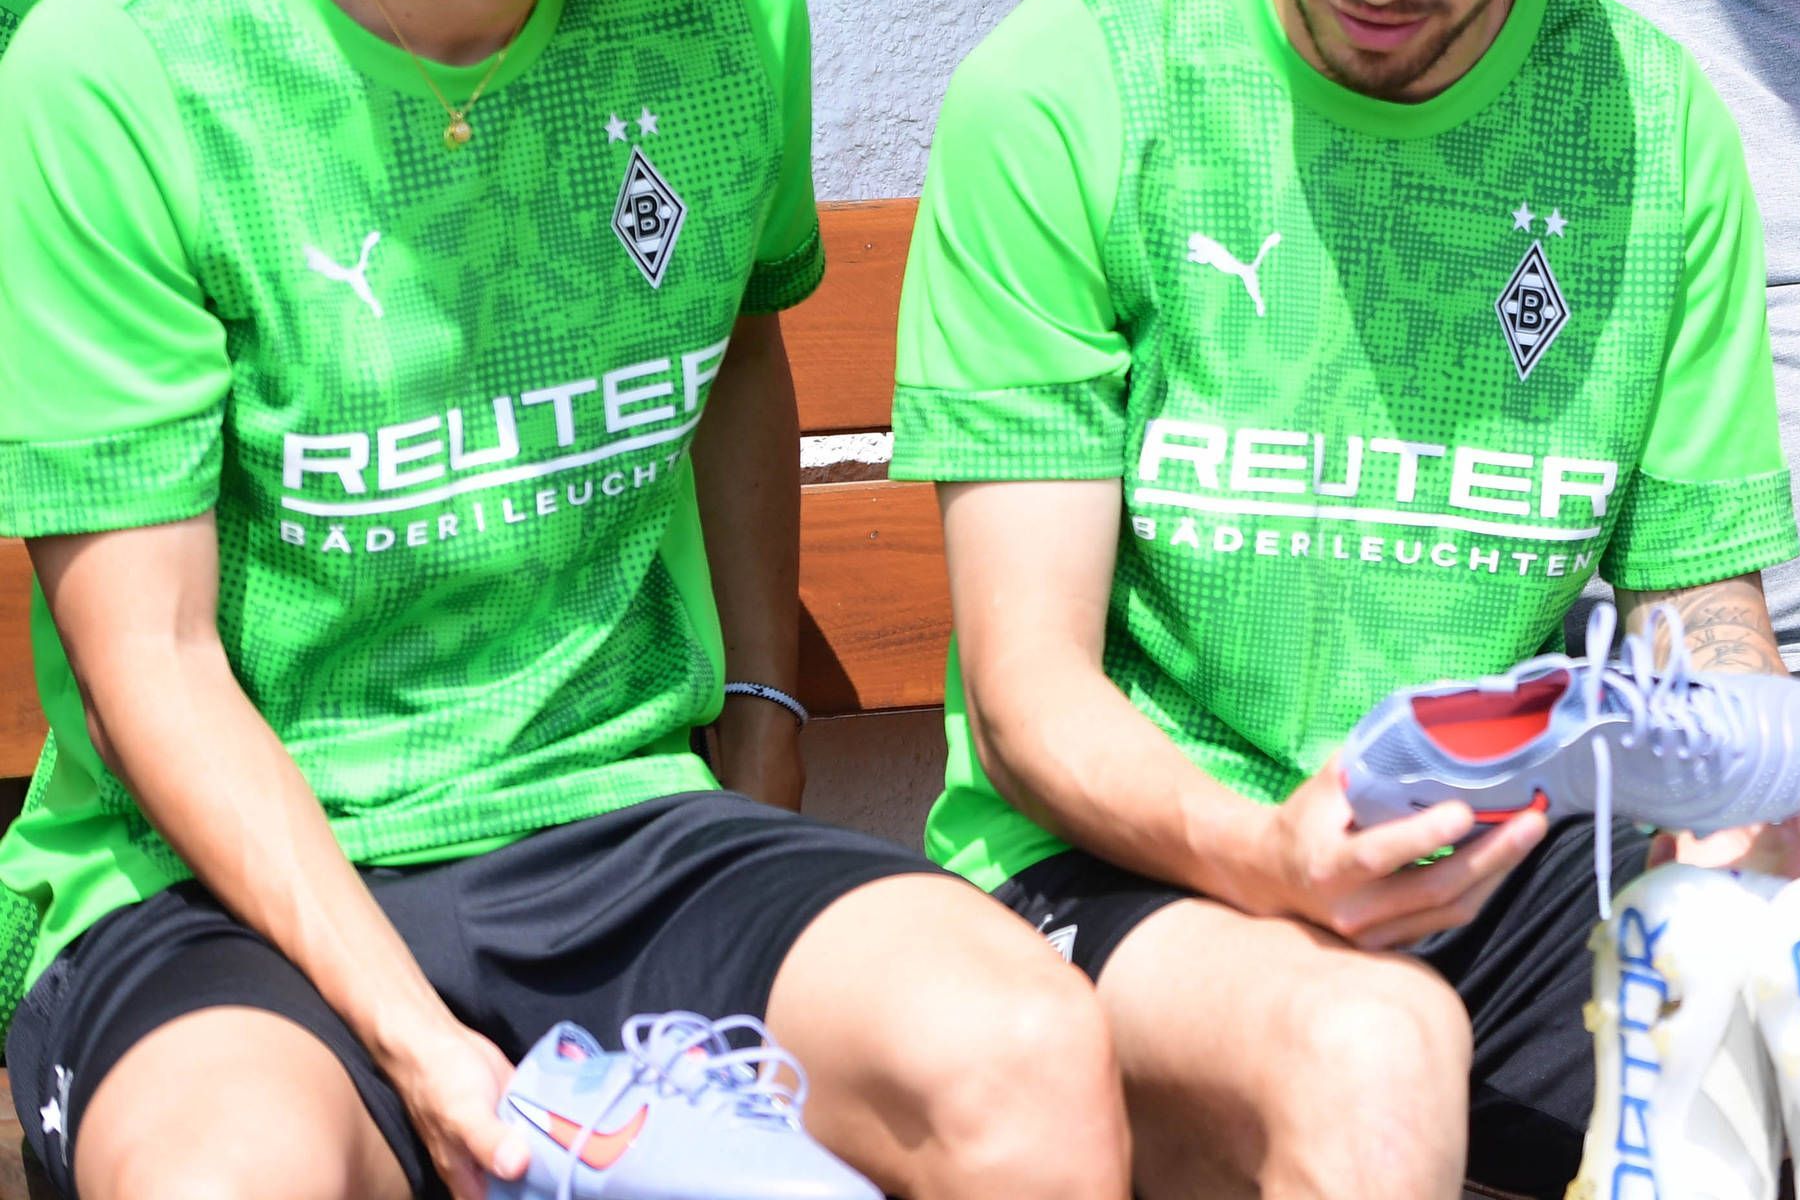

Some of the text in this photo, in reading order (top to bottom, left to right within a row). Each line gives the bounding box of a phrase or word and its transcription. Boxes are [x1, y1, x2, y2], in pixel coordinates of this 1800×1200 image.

[630, 191, 665, 242] B
[1516, 285, 1548, 333] B
[1137, 418, 1619, 519] REUTER
[280, 512, 458, 554] BÄDER
[1131, 516, 1596, 578] BÄDER LEUCHTEN
